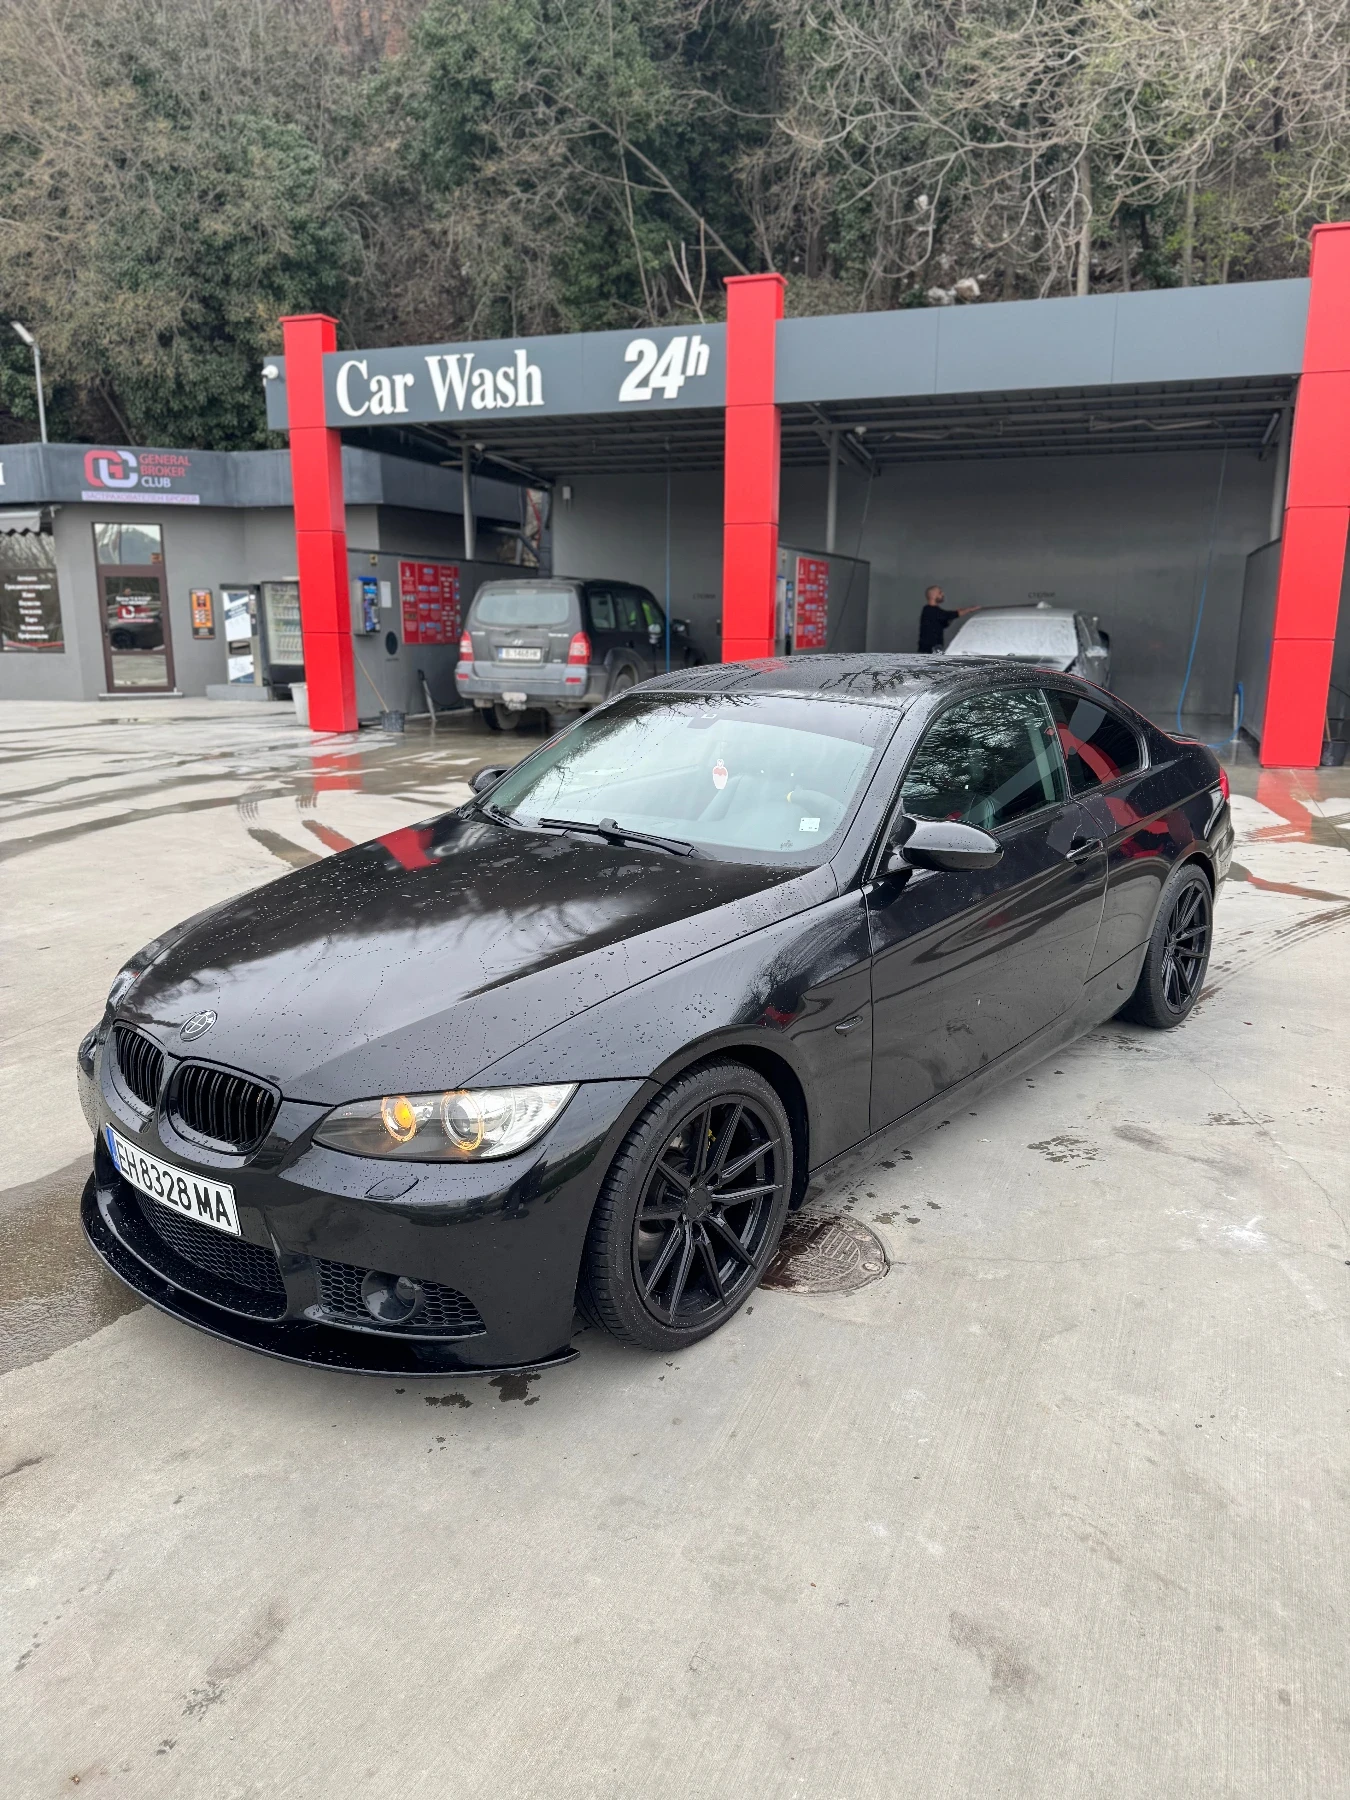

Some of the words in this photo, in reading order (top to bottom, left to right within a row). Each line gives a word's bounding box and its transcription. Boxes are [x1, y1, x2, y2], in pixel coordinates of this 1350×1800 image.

[336, 359, 414, 417] Car
[424, 349, 545, 412] Wash
[618, 335, 710, 402] 24h
[139, 453, 192, 467] GENERAL
[140, 466, 186, 477] BROKER
[141, 476, 172, 488] CLUB
